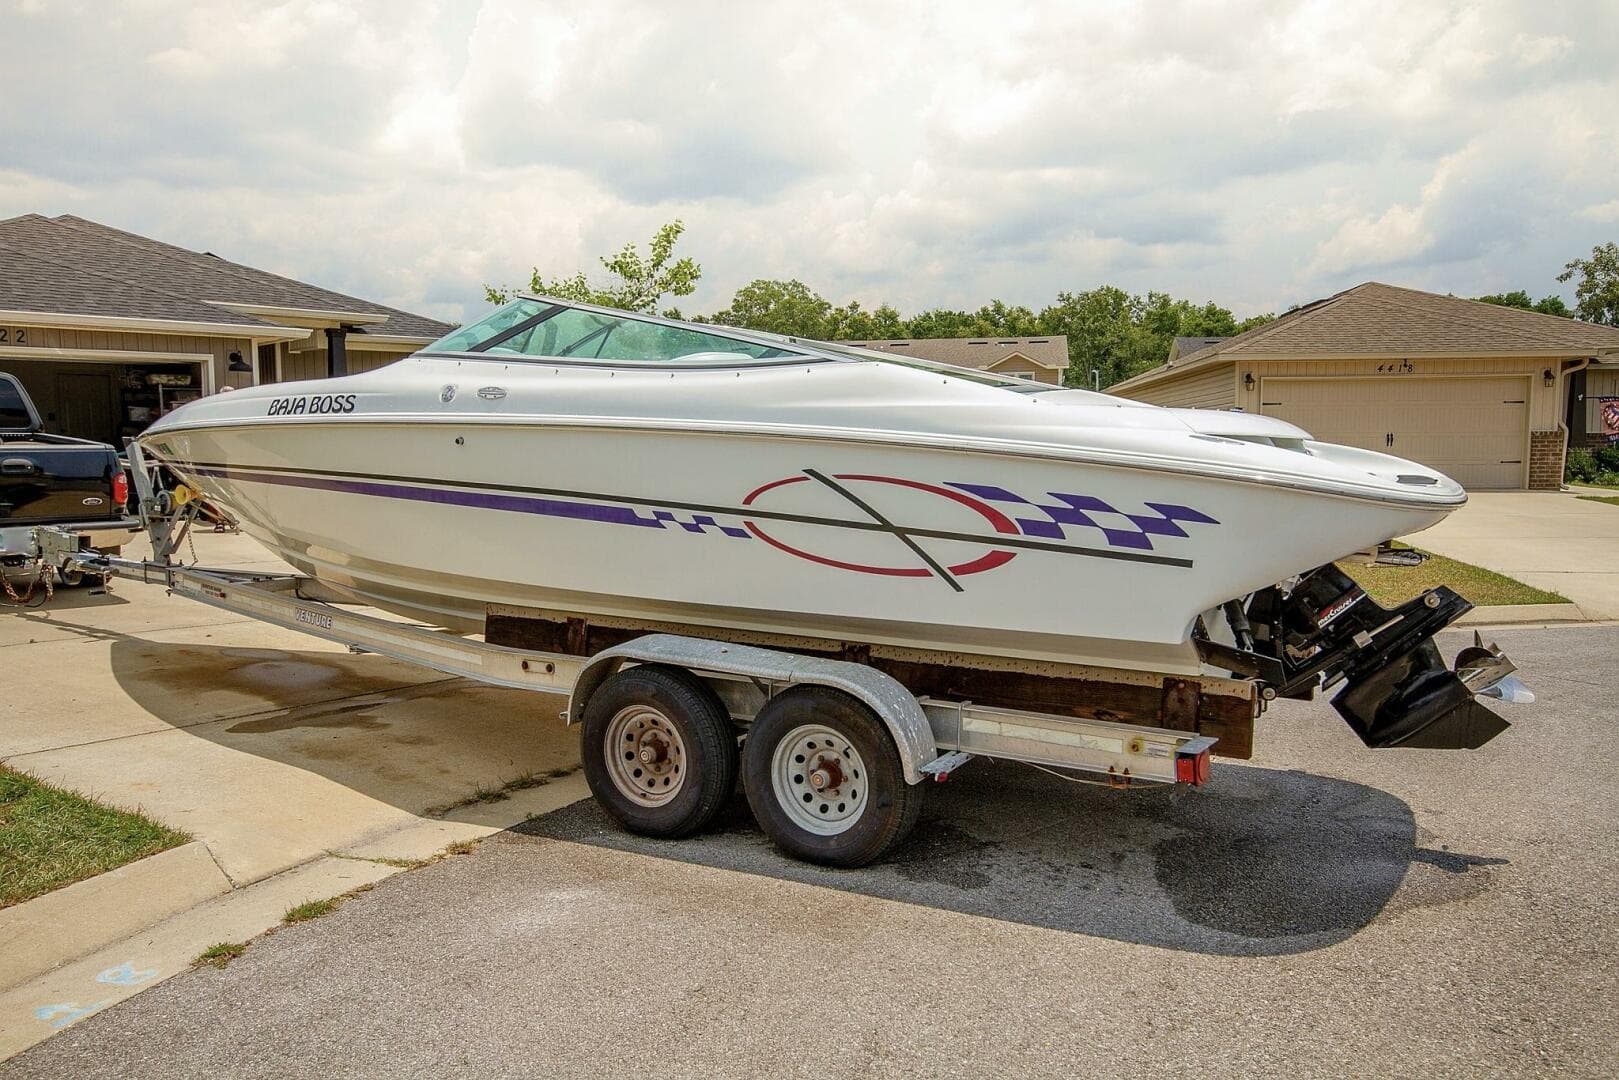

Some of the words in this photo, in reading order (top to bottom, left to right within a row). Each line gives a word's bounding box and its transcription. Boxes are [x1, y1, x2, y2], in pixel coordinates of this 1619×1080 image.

[1377, 363, 1413, 373] 4418
[267, 396, 306, 416] BAJA
[308, 394, 356, 414] BOSS
[295, 607, 332, 630] VENTURE
